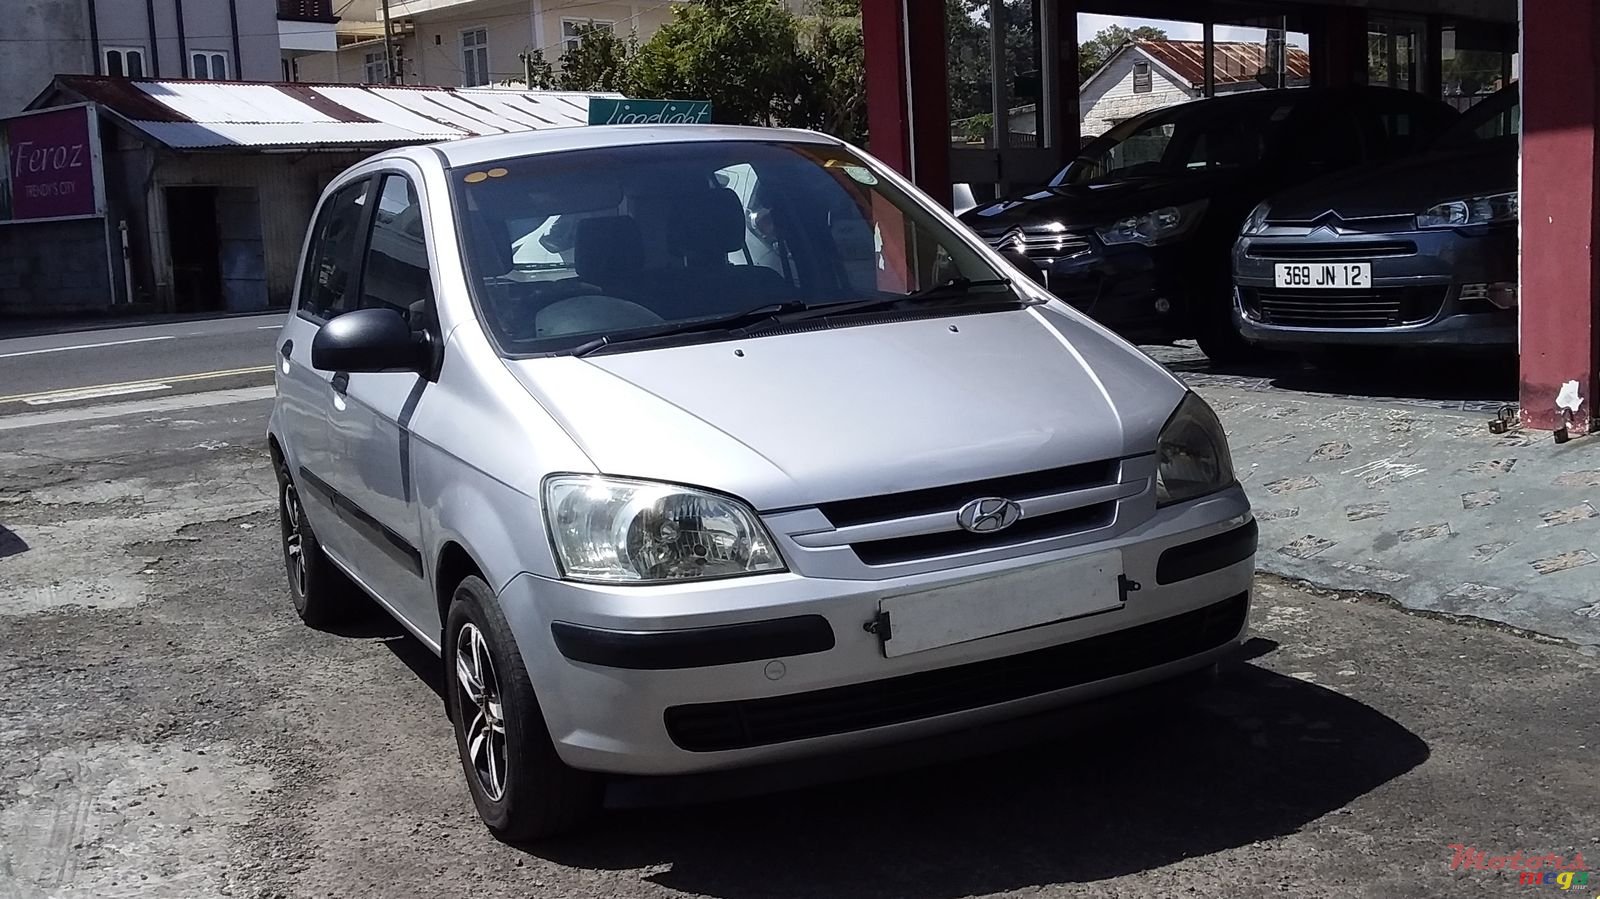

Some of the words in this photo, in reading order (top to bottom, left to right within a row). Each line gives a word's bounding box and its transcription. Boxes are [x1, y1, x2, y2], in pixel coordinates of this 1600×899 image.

[15, 141, 82, 177] Feroz
[59, 181, 76, 195] CITY
[1283, 266, 1310, 285] 369
[1316, 266, 1335, 285] JN
[1344, 266, 1361, 285] 12
